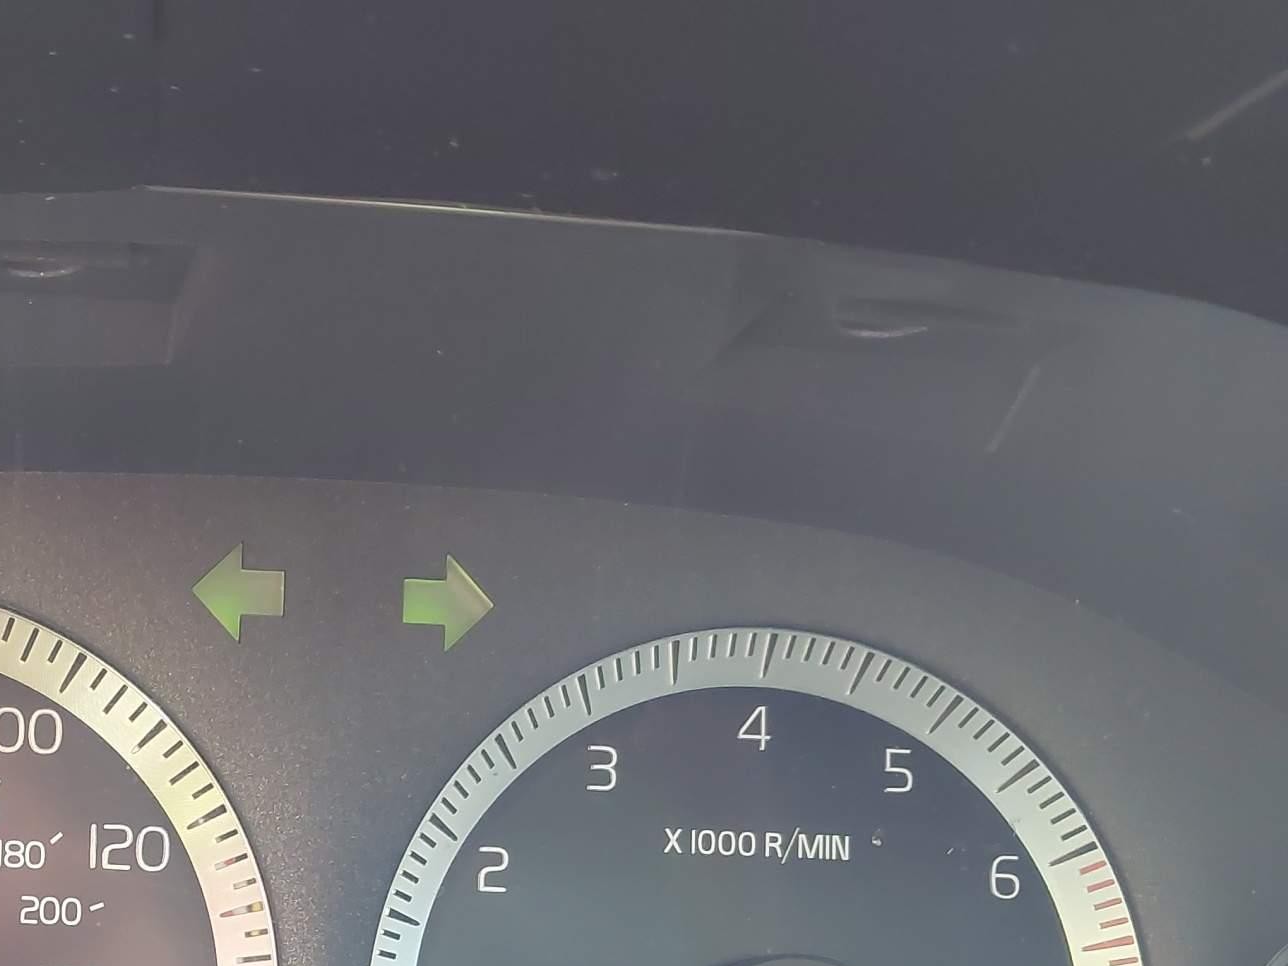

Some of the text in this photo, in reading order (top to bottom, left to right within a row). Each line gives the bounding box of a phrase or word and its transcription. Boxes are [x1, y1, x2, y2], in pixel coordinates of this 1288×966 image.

[737, 705, 771, 751] 4
[587, 744, 618, 791] 3
[884, 748, 914, 794] 5
[88, 824, 170, 872] 120
[664, 828, 851, 863] X 1000 R/MIN
[477, 846, 508, 893] 2
[989, 854, 1020, 899] 6
[20, 896, 81, 925] 200
